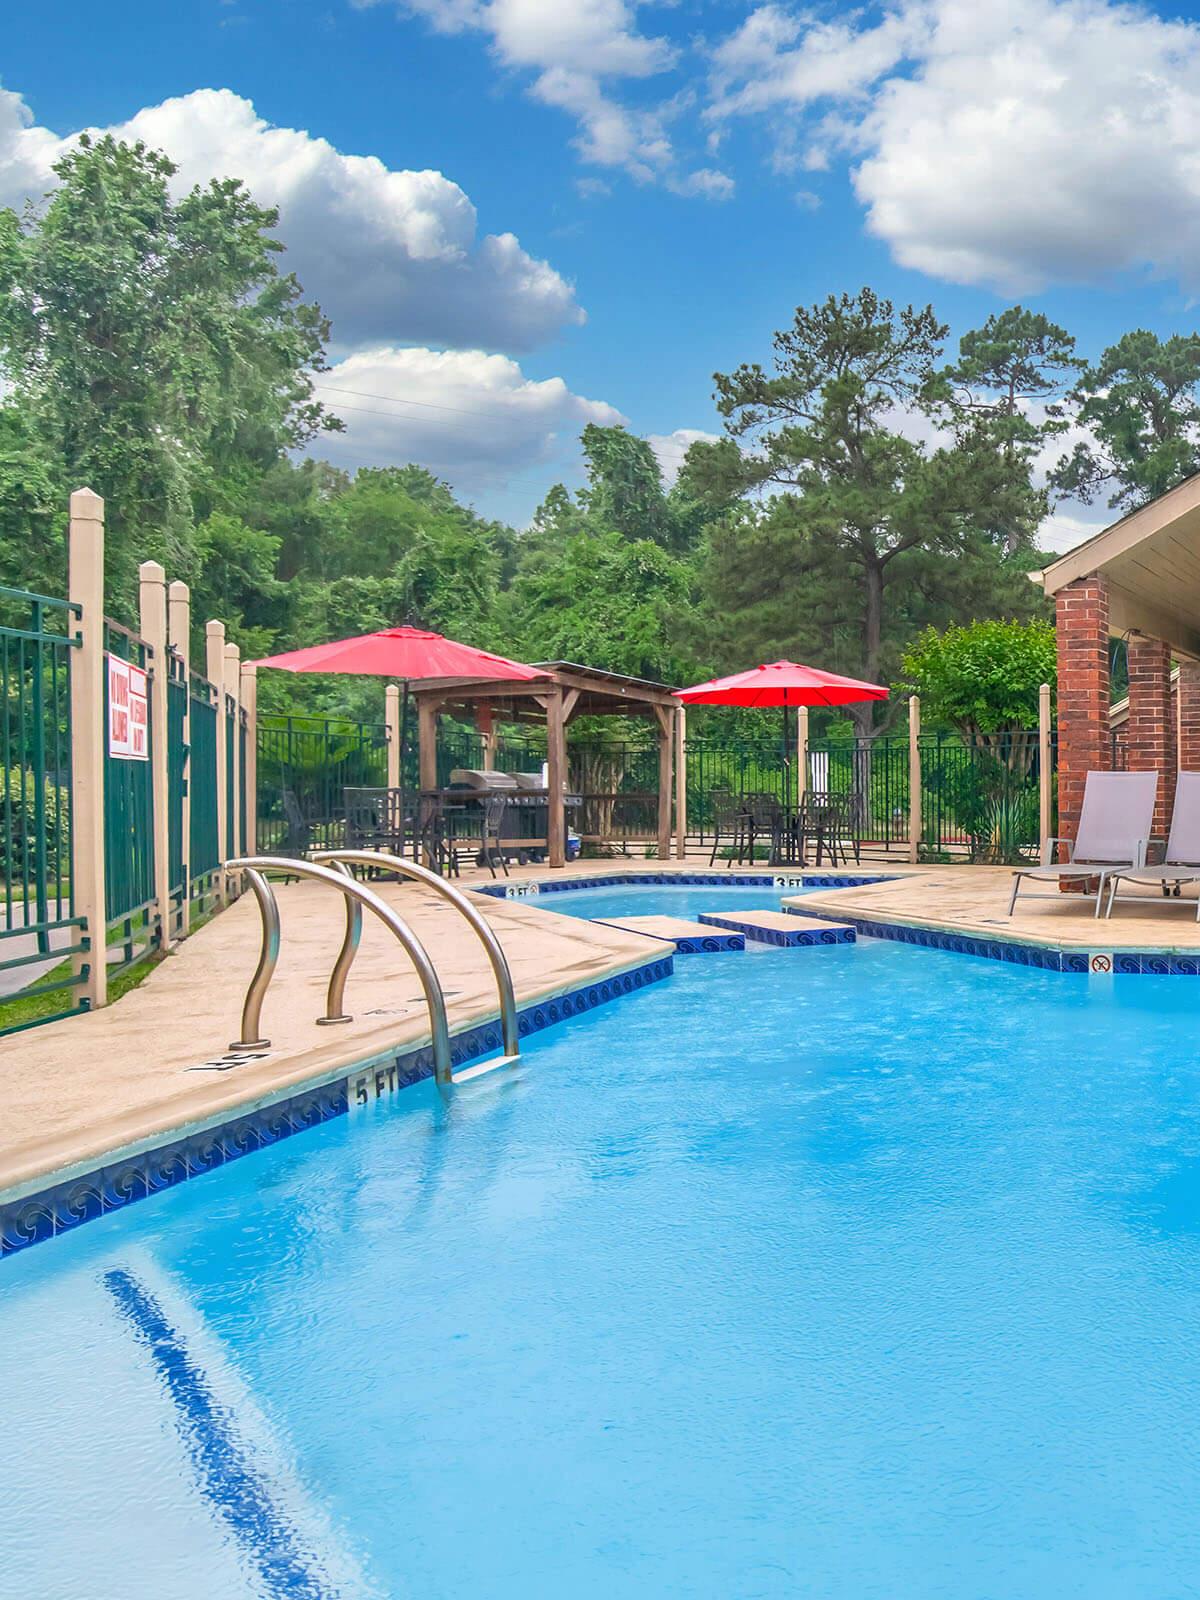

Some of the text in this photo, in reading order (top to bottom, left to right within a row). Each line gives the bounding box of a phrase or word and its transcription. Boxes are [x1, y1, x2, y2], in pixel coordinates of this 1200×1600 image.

[788, 878, 801, 888] FT
[355, 1065, 396, 1105] 5 FT
